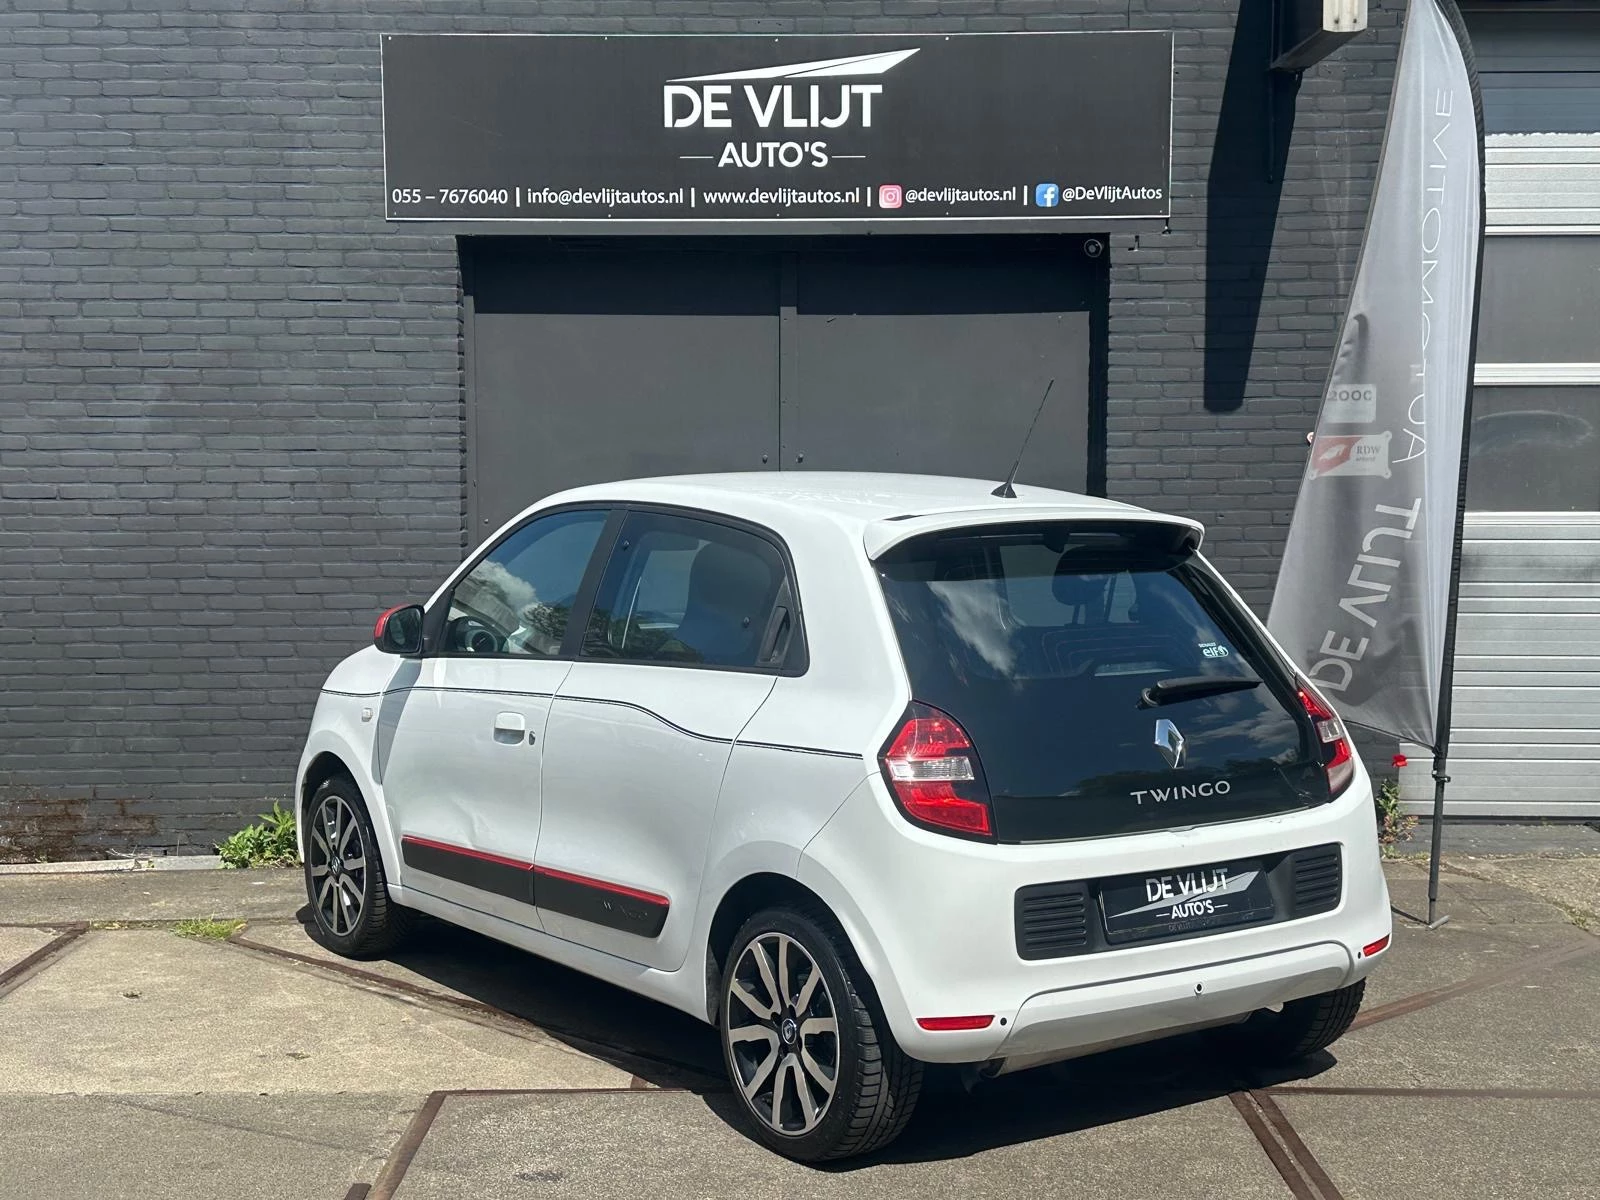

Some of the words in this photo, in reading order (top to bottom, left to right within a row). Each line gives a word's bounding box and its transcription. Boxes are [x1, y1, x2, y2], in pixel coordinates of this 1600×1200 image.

[664, 85, 732, 128] DE
[743, 85, 883, 128] VLIJT
[717, 141, 829, 168] AUTO'S
[391, 188, 422, 204] 055
[439, 188, 508, 205] 7676040
[527, 187, 684, 208] info@devlijtautos.nl
[703, 187, 860, 208] www.devlijtautos.nl
[905, 186, 1017, 208] @devlijtautos.nl
[1062, 185, 1163, 204] @DeVlijtAutos
[1356, 445, 1382, 455] RDW
[1130, 780, 1231, 805] TWINGO
[1145, 875, 1175, 902] DE
[1176, 867, 1228, 896] VLIJT
[1171, 899, 1215, 920] AUTO'S
